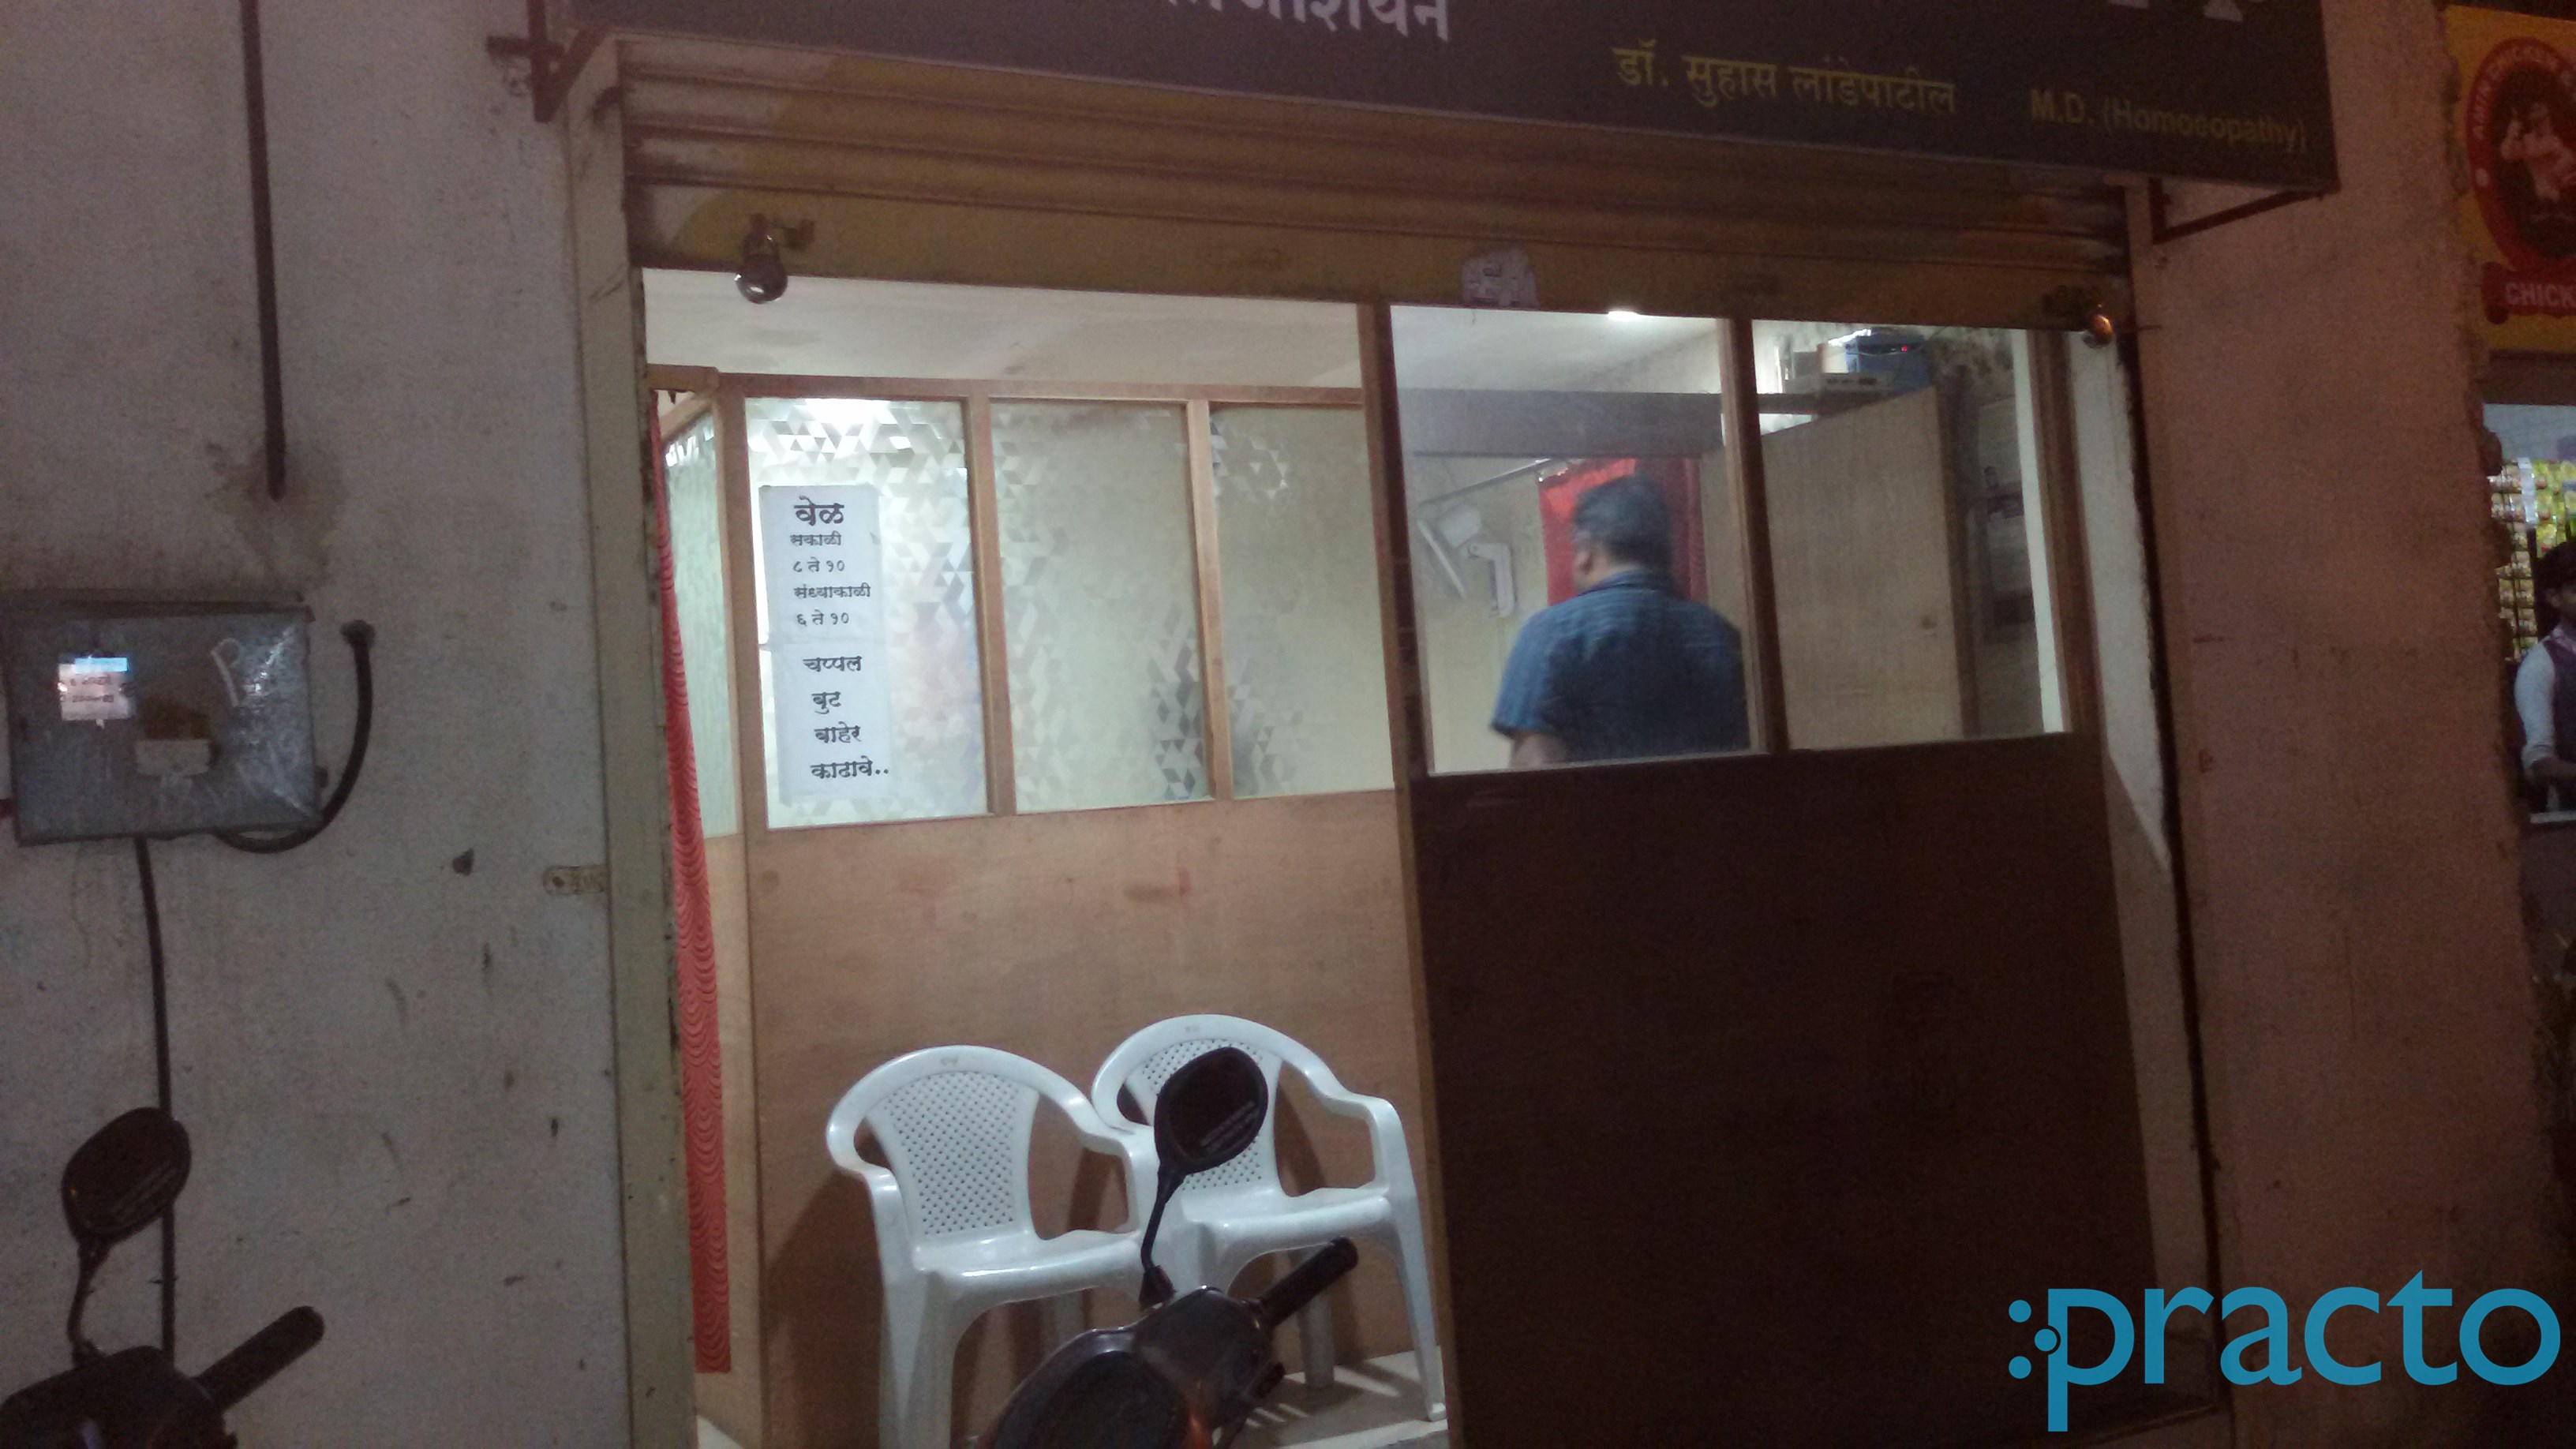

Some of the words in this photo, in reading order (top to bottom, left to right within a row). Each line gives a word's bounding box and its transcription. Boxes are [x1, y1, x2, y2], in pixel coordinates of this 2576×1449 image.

[1611, 37, 1670, 88] डॉ.
[1681, 54, 1780, 109] सुहास
[2027, 87, 2095, 128] M.D.
[793, 496, 844, 526] वेळ
[790, 530, 841, 547] सकाळी
[792, 560, 803, 572] ८
[807, 556, 820, 572] ते
[826, 560, 845, 572] १०
[793, 582, 871, 599] संध्याकाळी
[796, 614, 807, 626] ६
[811, 609, 824, 625] ते
[830, 612, 849, 625] १०
[803, 656, 862, 672] चप्पल
[811, 691, 841, 714] बुट
[814, 721, 862, 743] बाहेर
